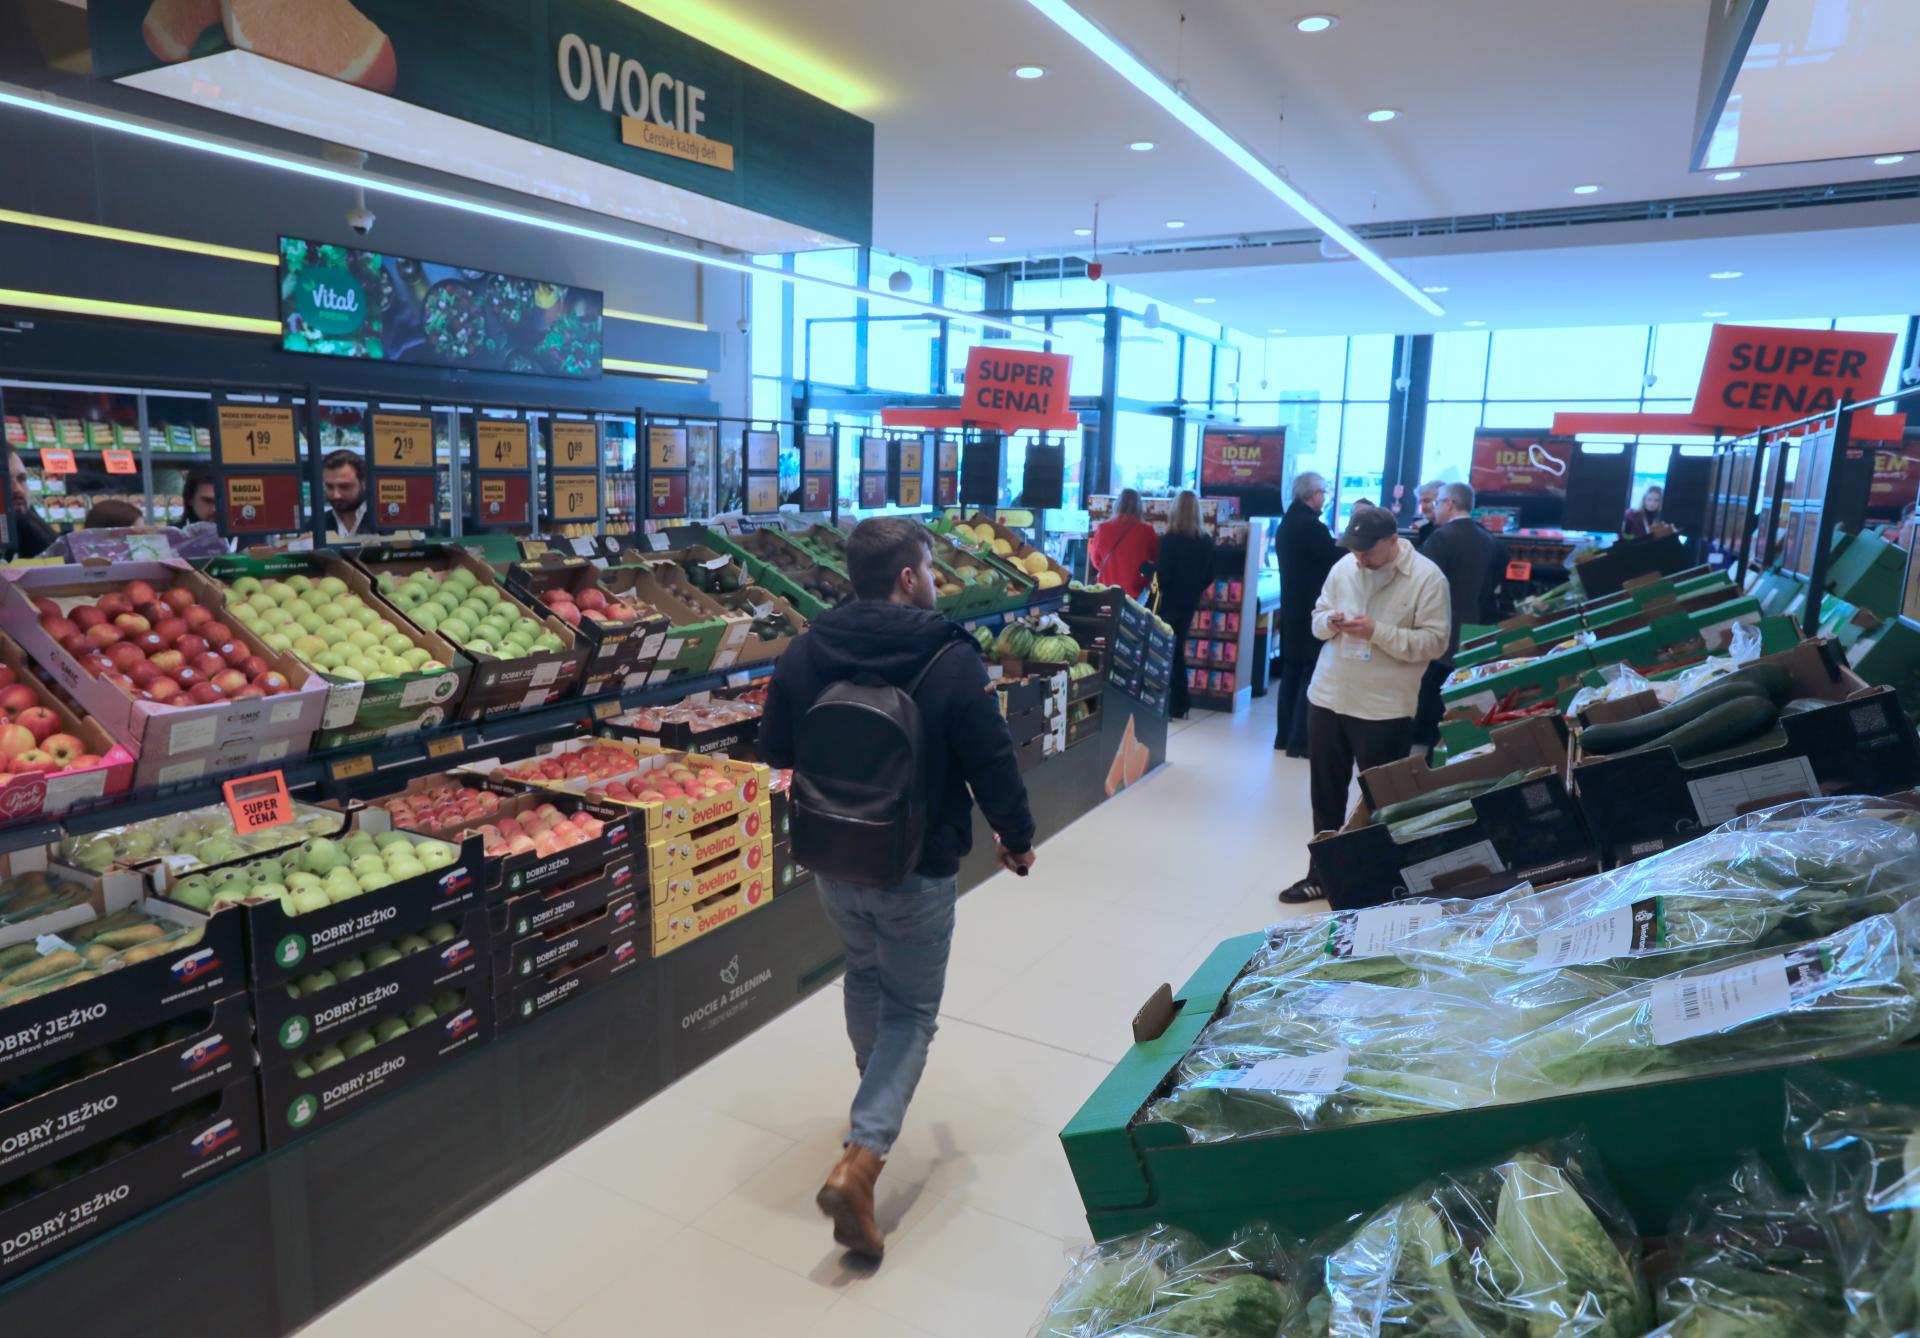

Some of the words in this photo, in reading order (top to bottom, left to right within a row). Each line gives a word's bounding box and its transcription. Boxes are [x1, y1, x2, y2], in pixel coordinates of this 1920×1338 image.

[558, 33, 706, 139] OVOCIE
[311, 283, 359, 312] Vital
[978, 359, 1055, 388] SUPER
[1727, 343, 1868, 379] SUPER
[976, 386, 1050, 415] CENA!
[1222, 447, 1261, 459] IDEM
[242, 798, 279, 816] SUPER
[248, 811, 278, 827] CENA
[693, 800, 733, 824] evelina
[695, 835, 736, 860] evelina
[526, 864, 548, 879] DOBRÝ
[698, 868, 737, 895] evelina
[311, 918, 355, 946] DOBRÝ
[356, 906, 397, 930] JEŽKO
[698, 903, 738, 932] evelina
[314, 997, 358, 1026] DOBRÝ
[359, 981, 400, 1007] JEŽKO
[682, 999, 719, 1029] OVOCIE
[720, 994, 728, 1007] A
[729, 968, 772, 1002] ZELENINA
[45, 1003, 107, 1036] JEŽKO
[322, 1073, 365, 1103] DOBRÝ
[366, 1056, 406, 1083] JEŽKO
[0, 1118, 54, 1153] OBRÝ
[57, 1095, 118, 1130] JEŽKO
[1, 1211, 67, 1255] DOBRÝ
[69, 1184, 130, 1222] JEŽKO
